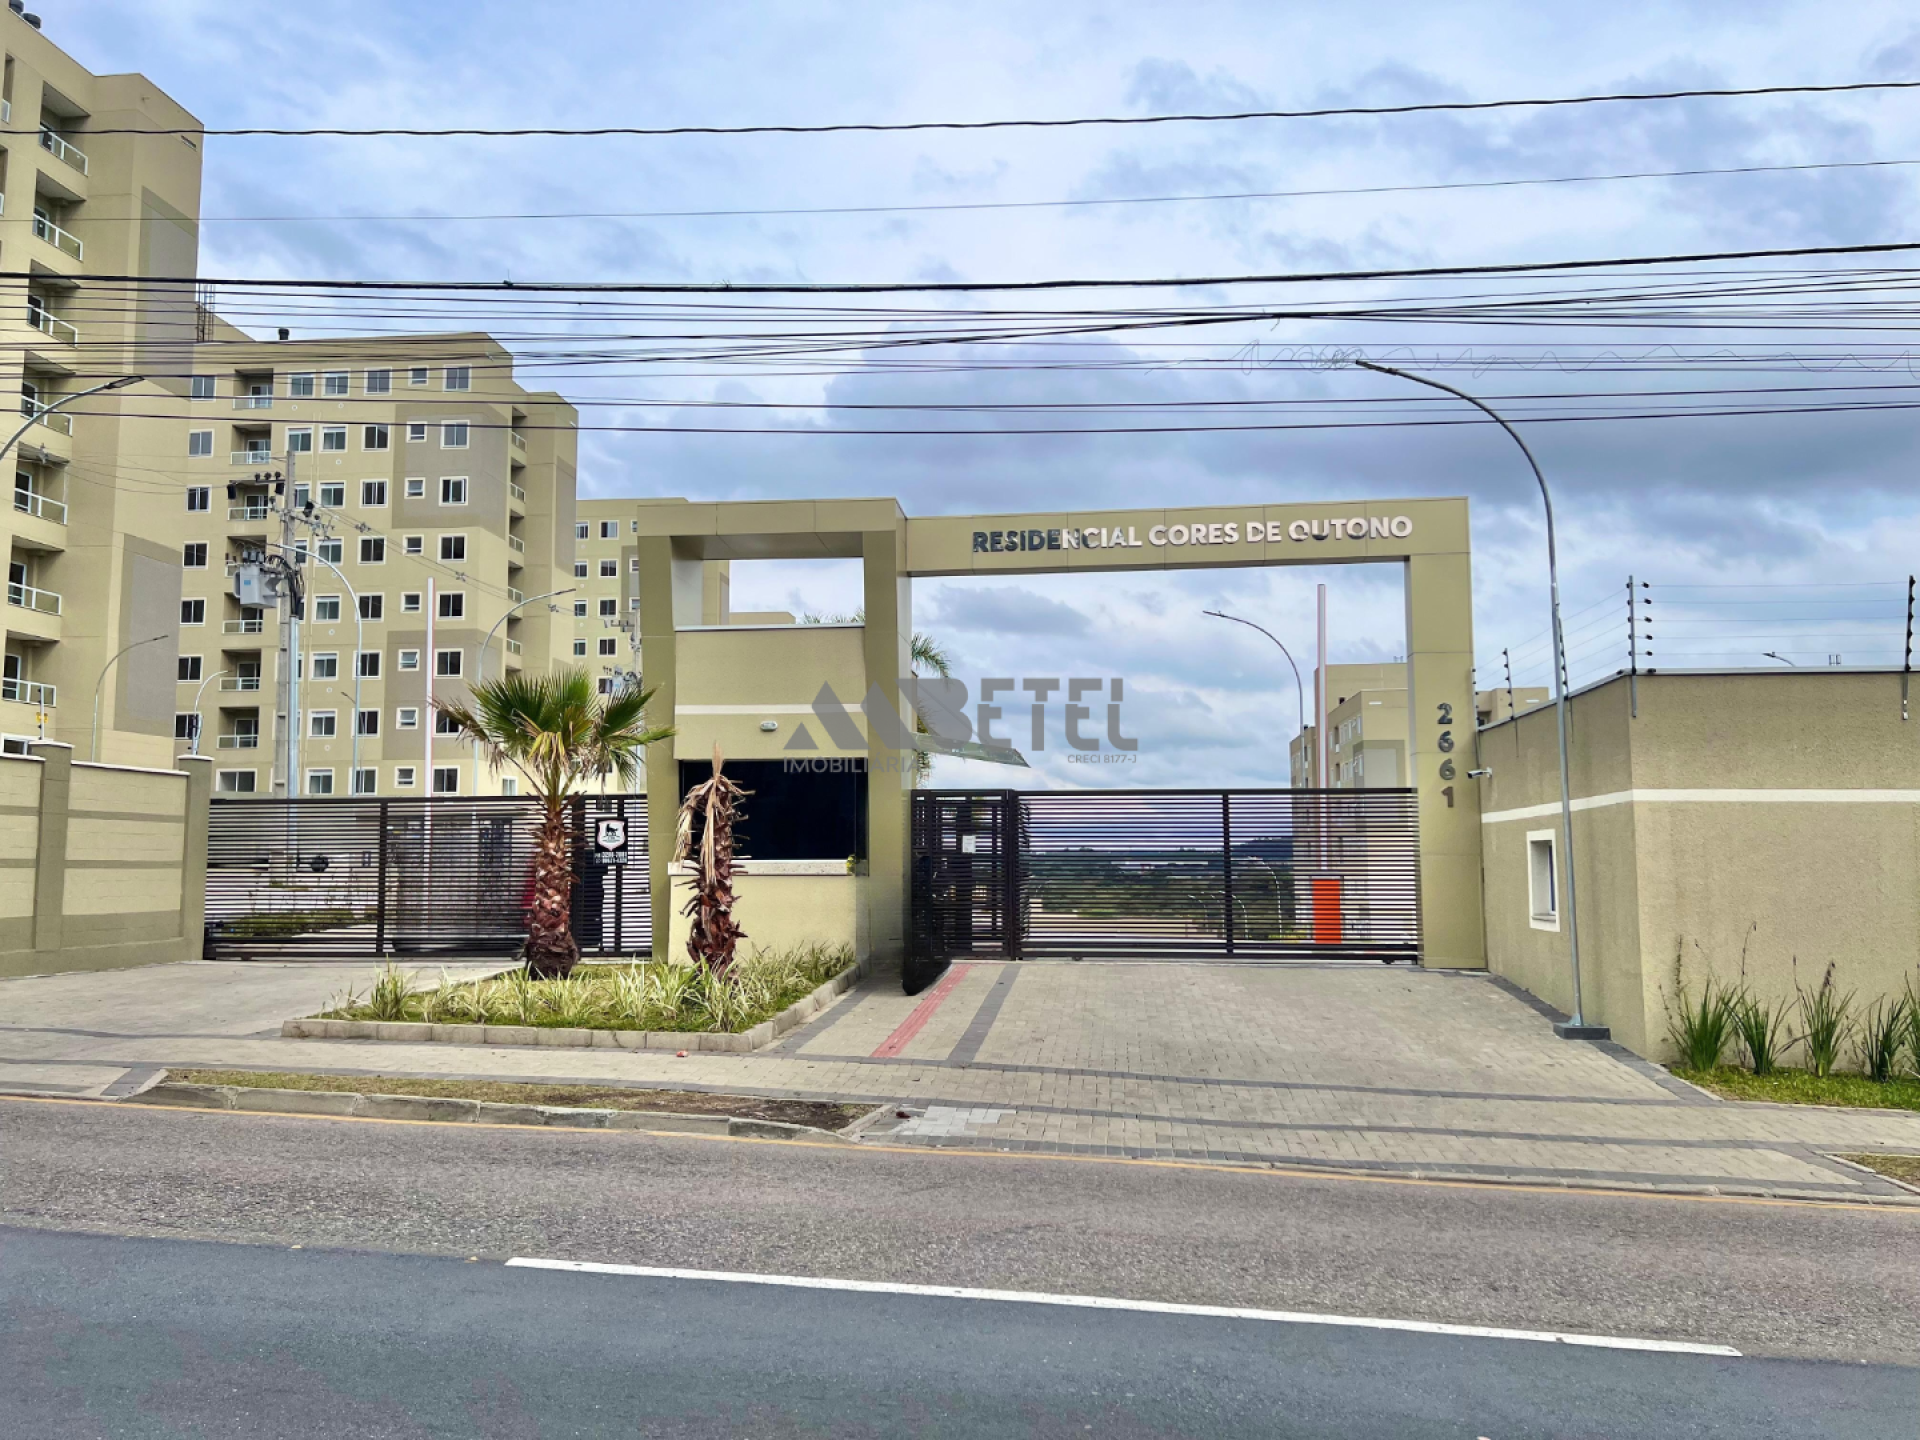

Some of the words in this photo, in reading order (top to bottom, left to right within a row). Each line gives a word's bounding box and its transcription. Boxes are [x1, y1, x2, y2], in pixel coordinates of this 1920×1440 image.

[972, 526, 1143, 553] RESIDENCIAL
[1148, 521, 1240, 549] CORES
[1246, 520, 1282, 543] DE
[1288, 515, 1413, 541] OUTONO
[1436, 702, 1456, 808] 2661
